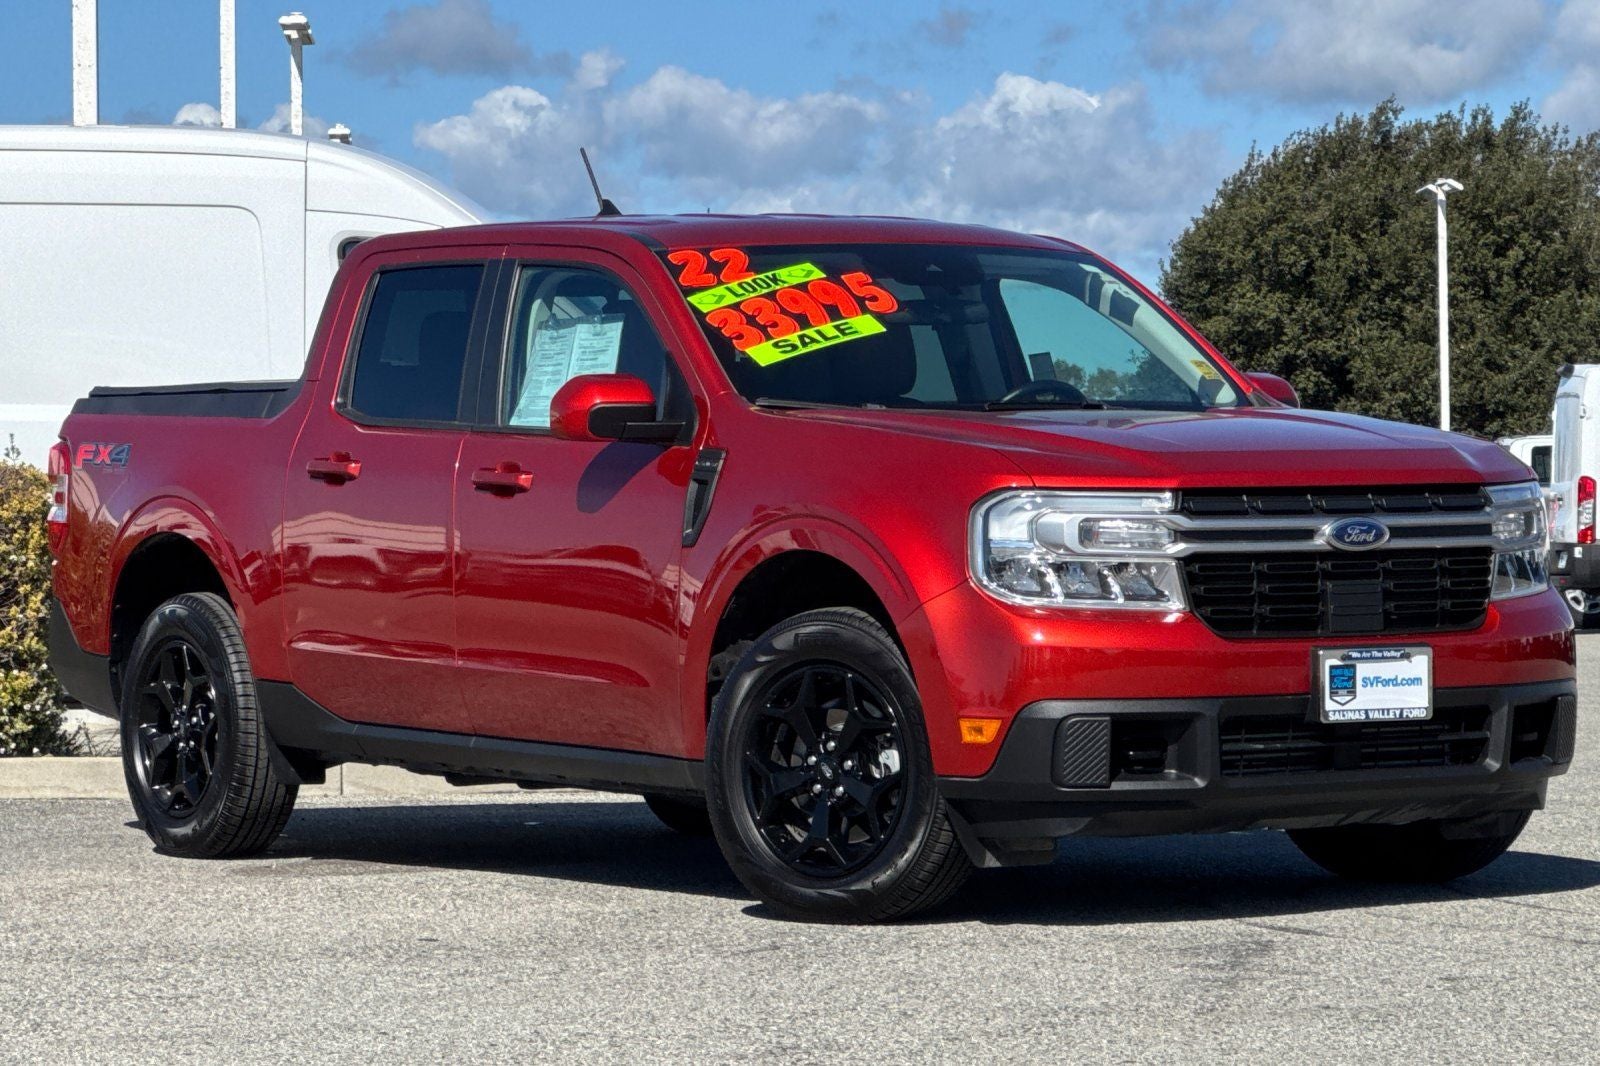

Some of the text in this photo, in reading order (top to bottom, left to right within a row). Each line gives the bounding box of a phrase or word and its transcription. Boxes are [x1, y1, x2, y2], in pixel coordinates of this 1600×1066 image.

[667, 247, 755, 287] 22
[725, 272, 789, 298] LOOK
[705, 271, 898, 352] 33995
[771, 320, 860, 355] SALE
[75, 442, 133, 469] FX4
[1344, 525, 1376, 543] Ford
[1361, 675, 1423, 688] SVFord.com
[1328, 708, 1427, 721] SALINAS VALLEY FORD
